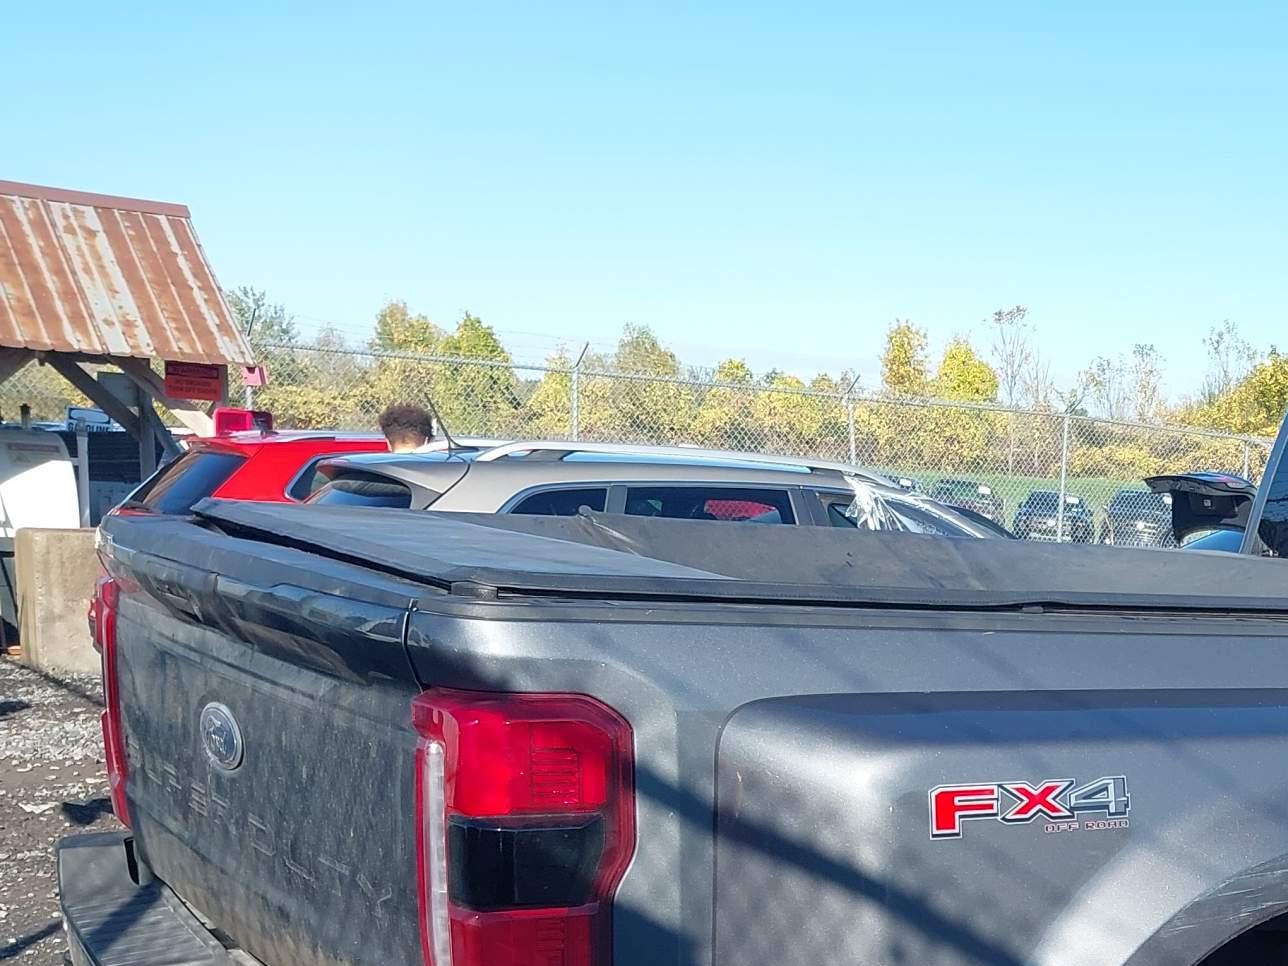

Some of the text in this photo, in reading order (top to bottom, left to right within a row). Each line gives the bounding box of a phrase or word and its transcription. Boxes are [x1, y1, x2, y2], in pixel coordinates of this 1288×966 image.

[928, 775, 1131, 840] FX4
[1044, 819, 1129, 833] OFF ROAD
